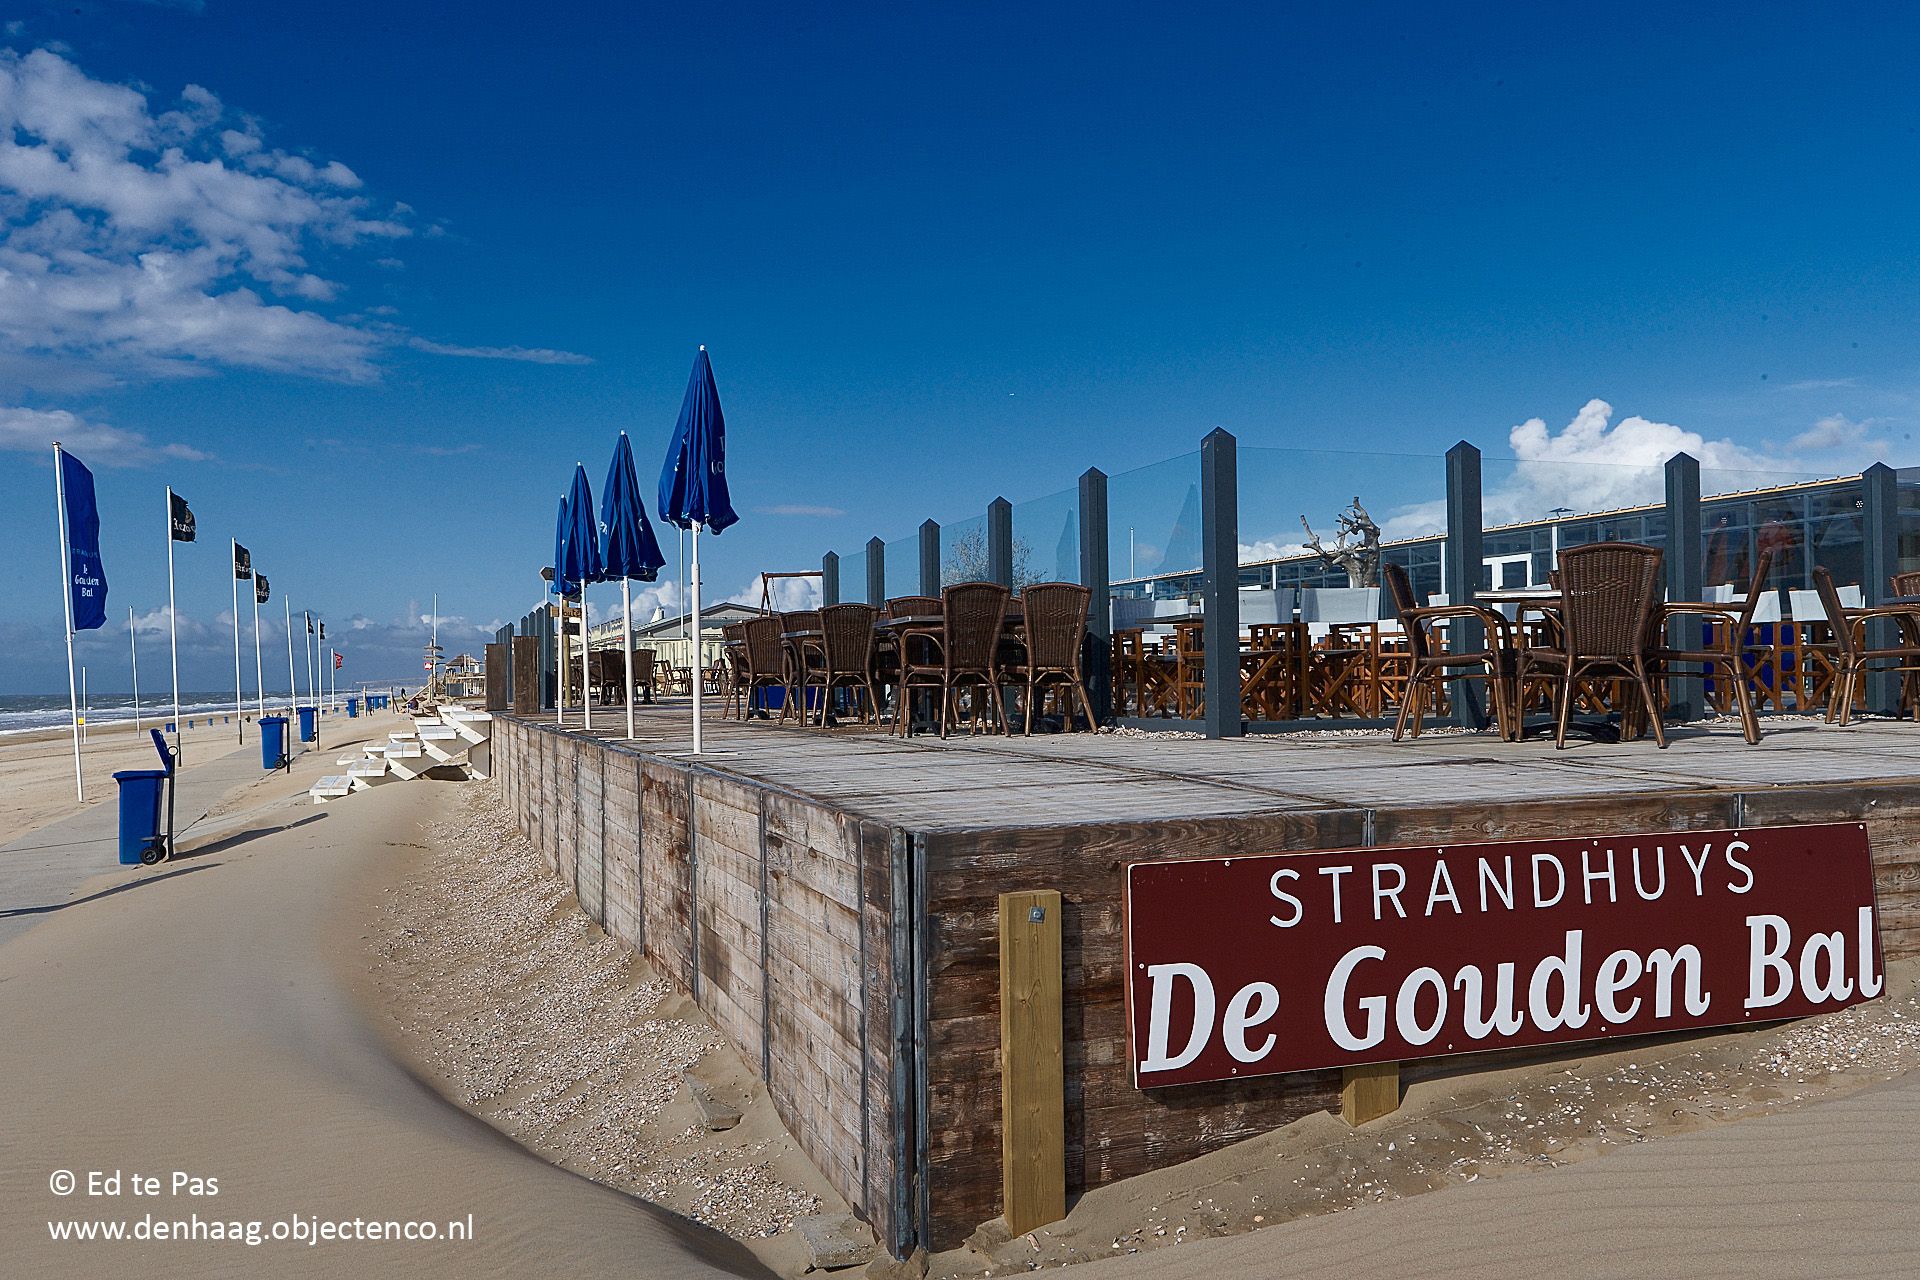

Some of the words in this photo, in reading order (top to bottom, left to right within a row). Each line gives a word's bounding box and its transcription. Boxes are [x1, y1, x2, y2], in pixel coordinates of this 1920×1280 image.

[81, 587, 94, 597] Bal
[1269, 840, 1755, 928] STRANDHUYS
[1139, 962, 1280, 1074] De
[1324, 929, 1711, 1051] Gouden
[1743, 905, 1884, 1009] Bal
